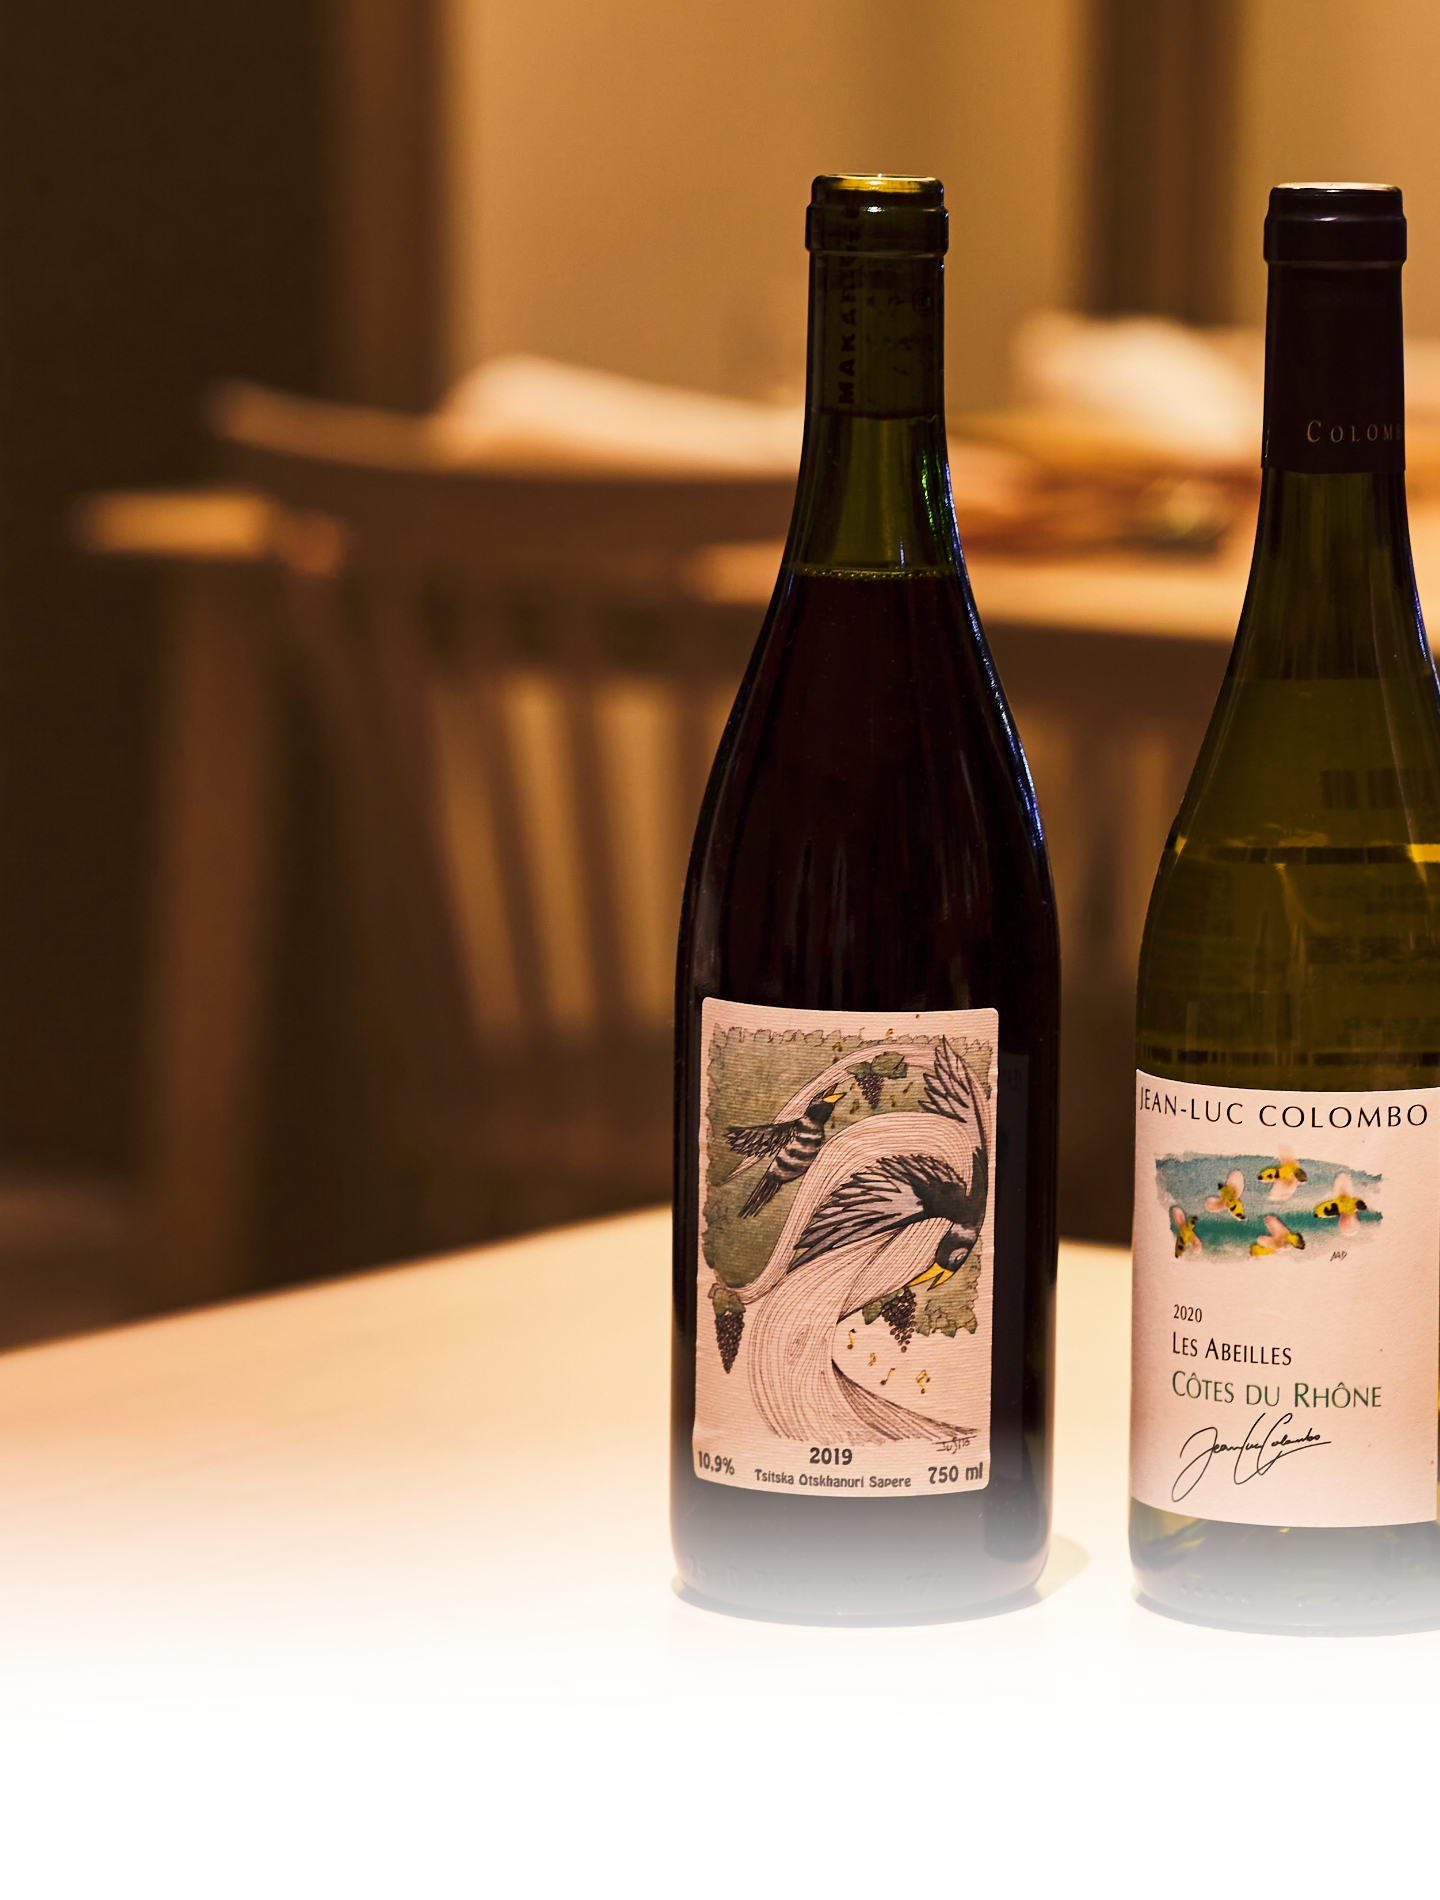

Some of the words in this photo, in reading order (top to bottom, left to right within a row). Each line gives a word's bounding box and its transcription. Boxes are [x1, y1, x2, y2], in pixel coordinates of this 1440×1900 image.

[1140, 1087, 1243, 1125] JEAN-LUC
[1258, 1103, 1428, 1129] COLOMBO
[1173, 1303, 1203, 1323] 2020
[1172, 1331, 1198, 1357] LES
[1204, 1337, 1292, 1366] ABEILLES
[1172, 1370, 1235, 1404] CÔTES
[1246, 1384, 1280, 1407] DU
[1294, 1381, 1383, 1409] RHÔNE
[809, 1446, 853, 1466] 2019
[754, 1468, 795, 1486] Tsitska
[798, 1473, 864, 1489] Otskhanuri
[868, 1475, 912, 1489] Sapere
[927, 1465, 959, 1485] 750
[965, 1461, 983, 1481] ml
